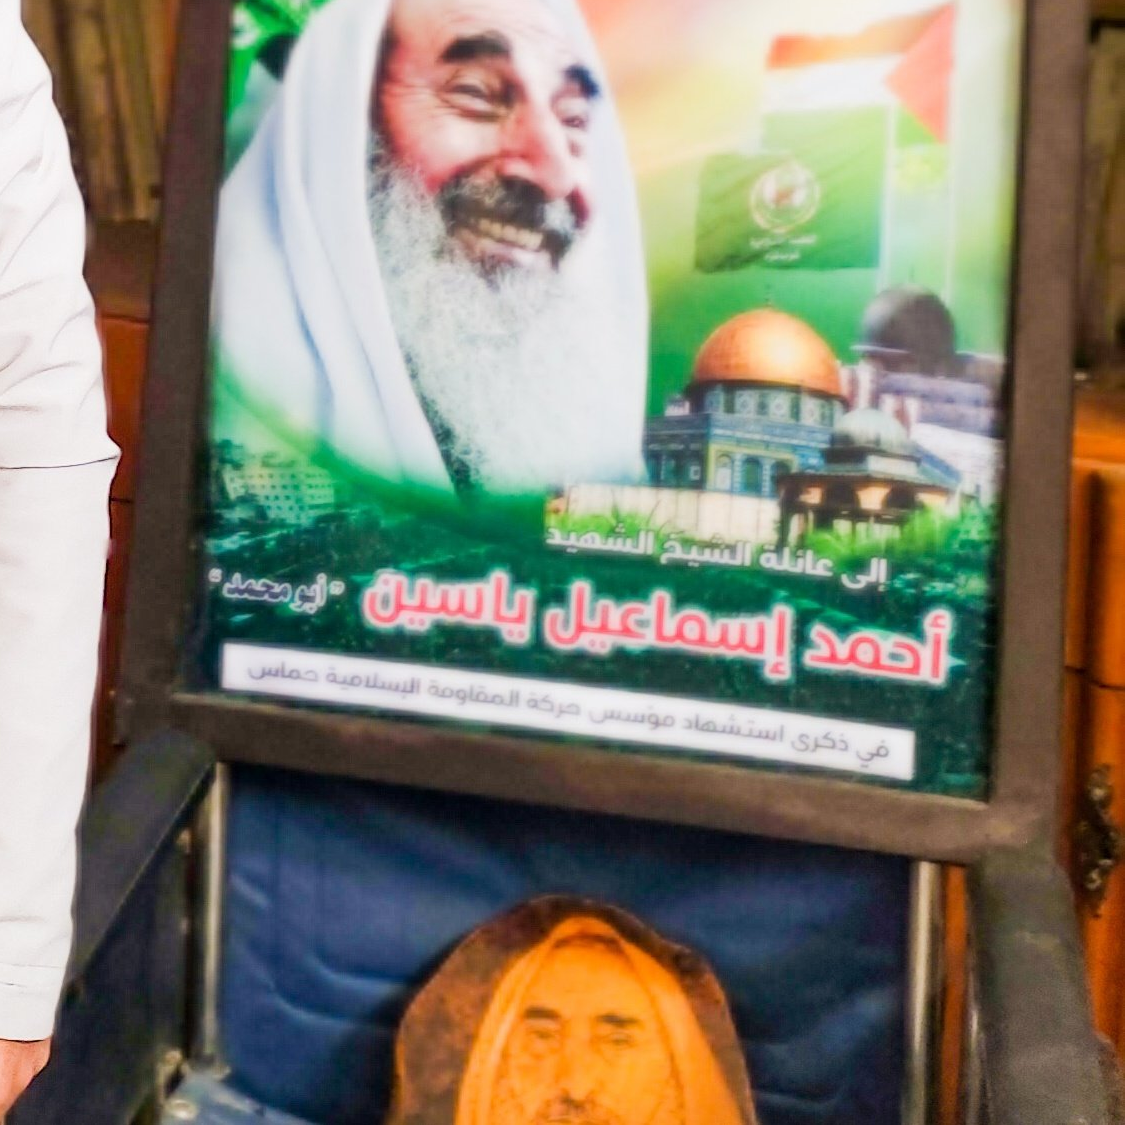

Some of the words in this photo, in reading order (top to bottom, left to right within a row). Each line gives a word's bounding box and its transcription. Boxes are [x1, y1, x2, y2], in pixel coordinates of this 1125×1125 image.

[545, 523, 655, 556] الشهيد
[660, 531, 751, 567] الشيخ
[758, 544, 835, 577] عائلة
[841, 557, 889, 592] إلى
[362, 566, 536, 645] ياسين
[543, 579, 794, 681] إسماعيل
[802, 607, 952, 684] أحمد
[246, 661, 319, 683] حماس
[325, 665, 421, 701] الإسلامية
[427, 678, 521, 709] المقاومة
[526, 691, 581, 718] حركة
[589, 703, 676, 731] مؤسس
[683, 713, 784, 743] استشهاد
[791, 730, 849, 754] ذكرى
[856, 740, 890, 768] في
